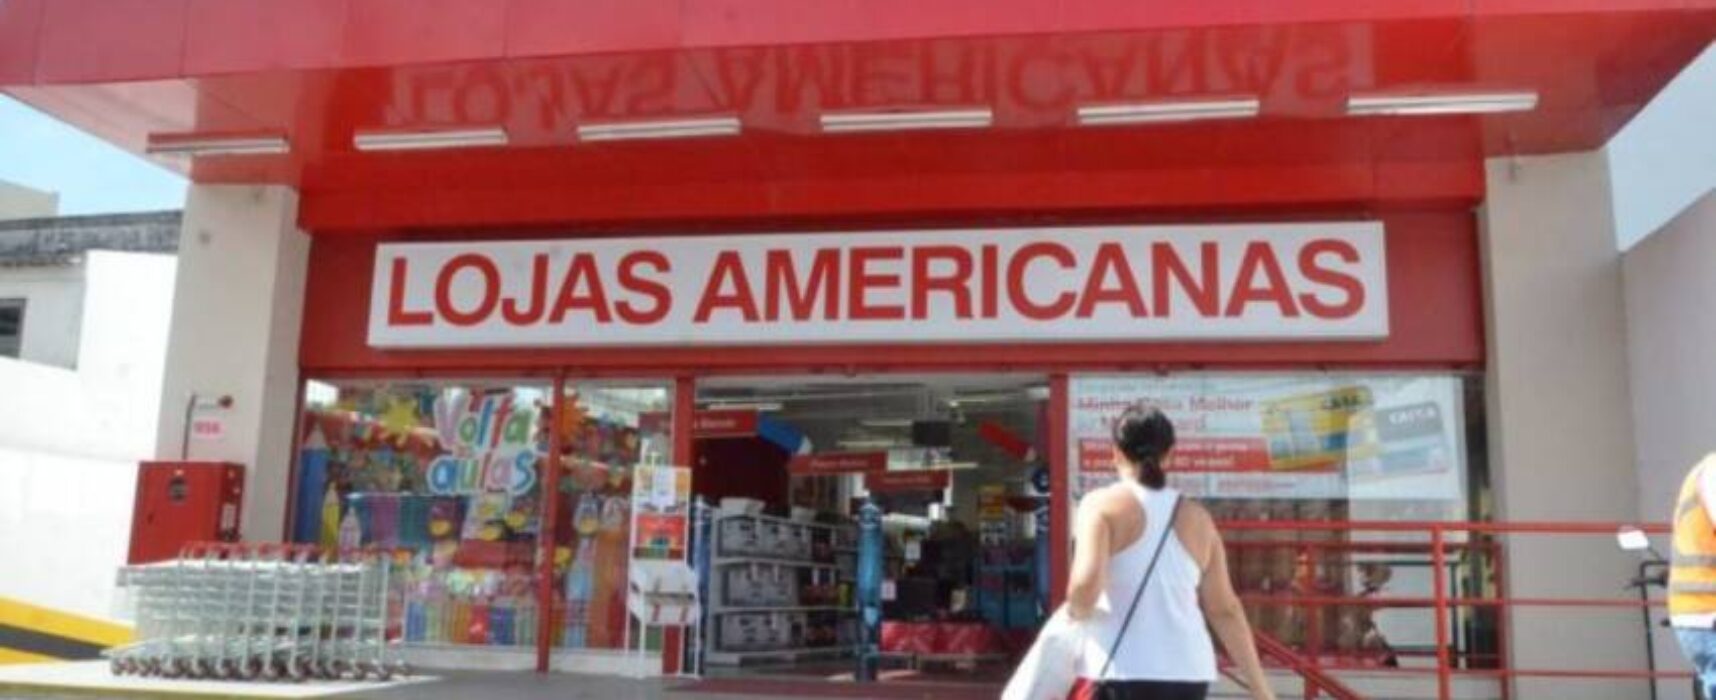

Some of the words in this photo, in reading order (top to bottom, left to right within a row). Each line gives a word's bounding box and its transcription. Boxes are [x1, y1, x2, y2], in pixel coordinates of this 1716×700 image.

[389, 251, 672, 326] LOJAS
[696, 240, 1364, 322] AMERICANAS
[428, 449, 535, 493] aulas
